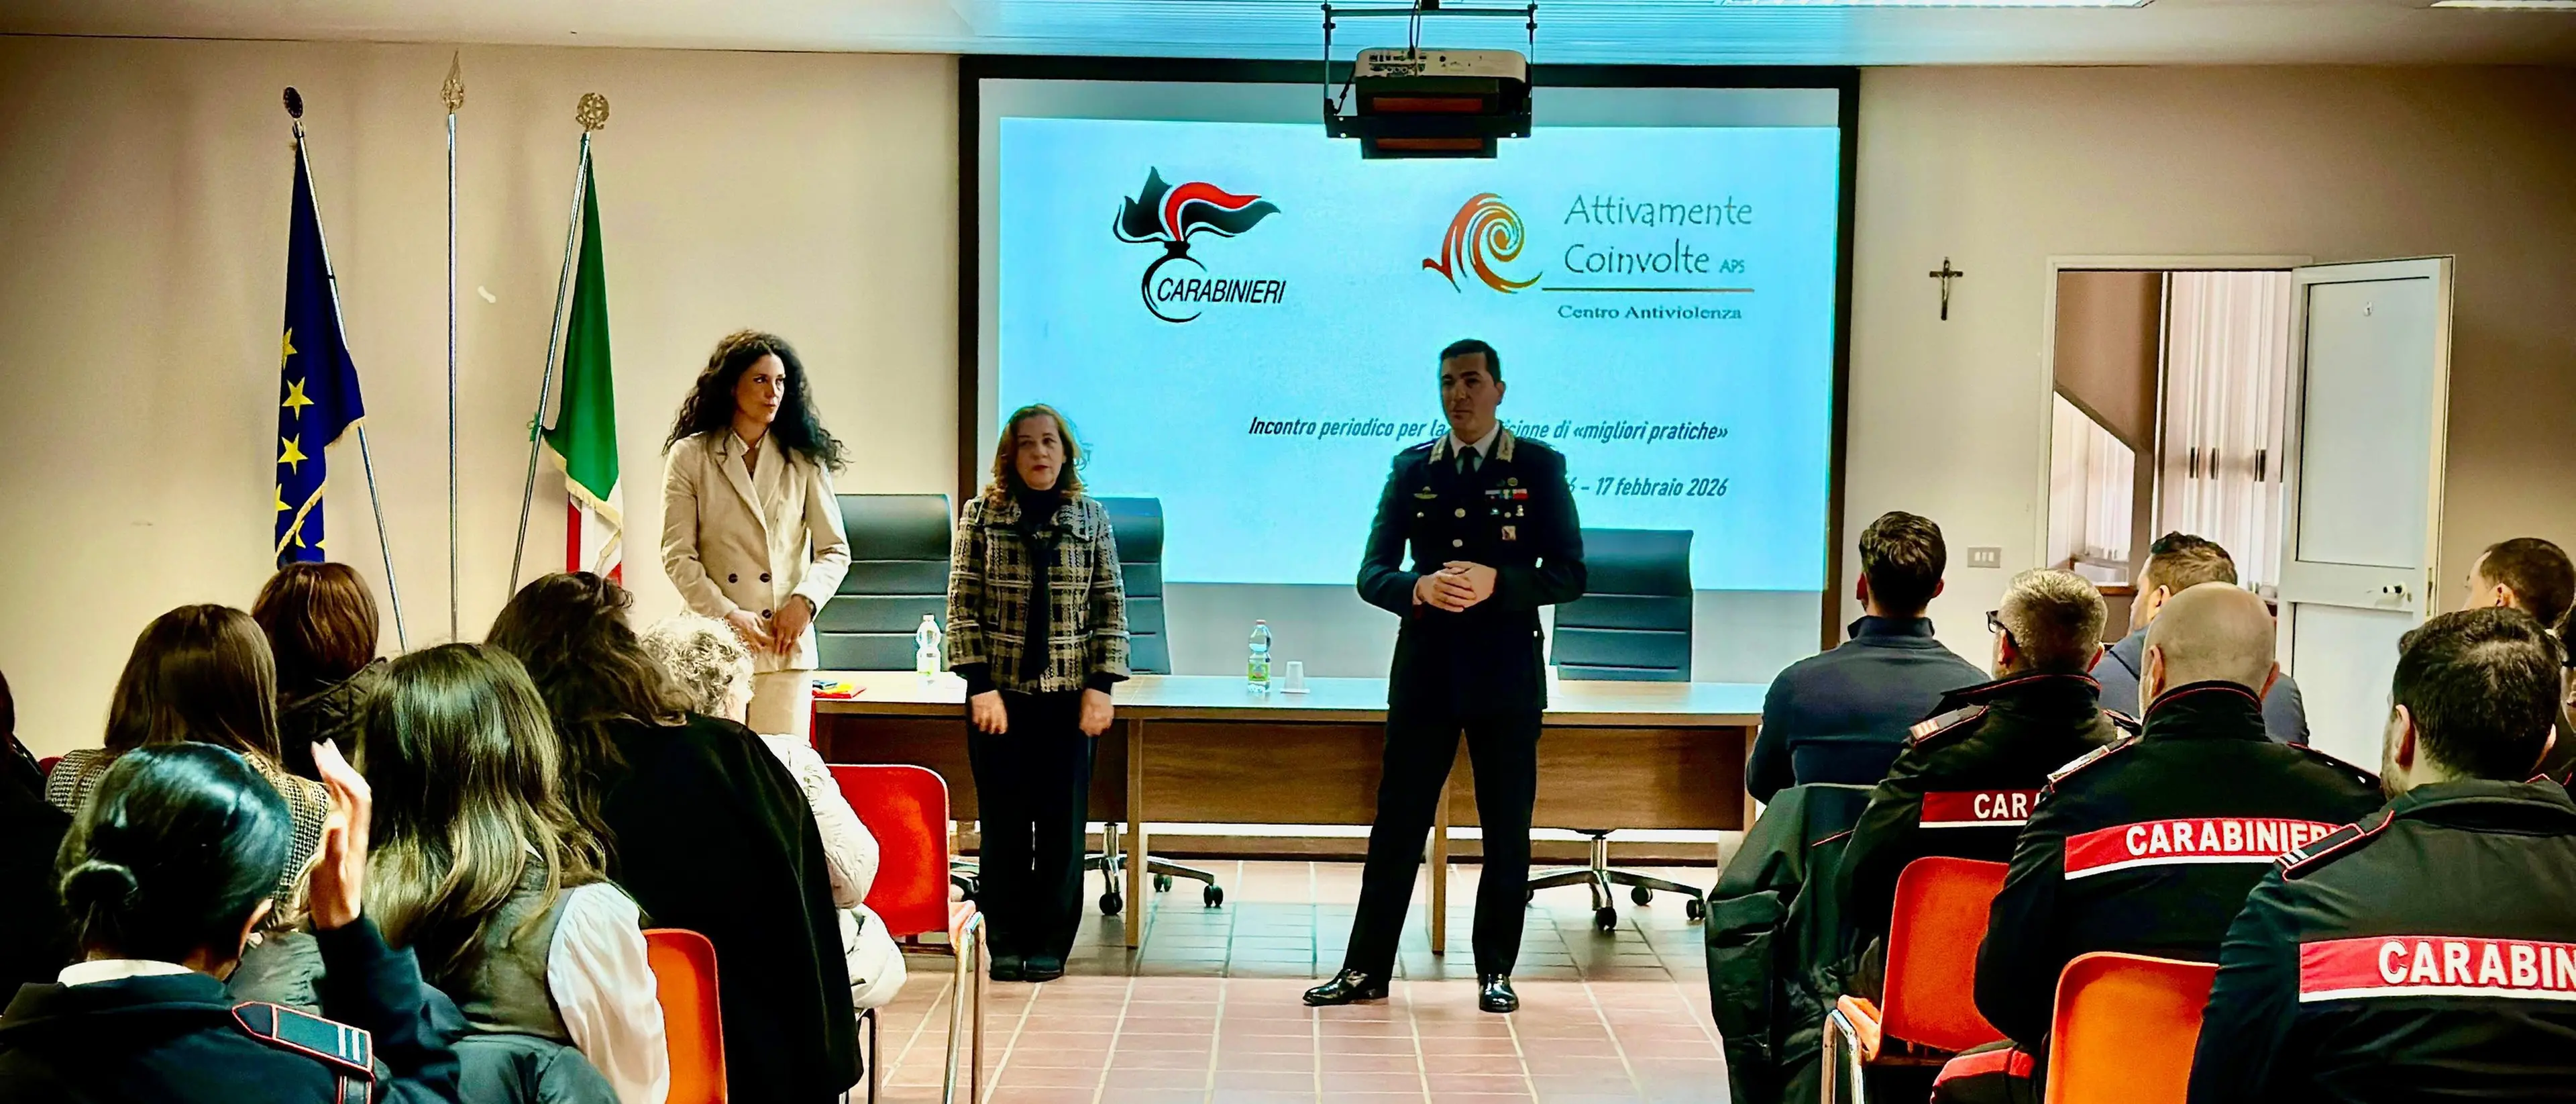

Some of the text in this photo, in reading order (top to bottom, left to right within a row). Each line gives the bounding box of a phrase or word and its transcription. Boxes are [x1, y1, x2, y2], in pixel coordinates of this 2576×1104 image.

[1564, 195, 1752, 227] Attivamente
[1564, 238, 1746, 274] Coinvolte APS
[1157, 277, 1287, 304] CARABINIERI
[1557, 305, 1742, 319] Centro Antiviolenza
[1248, 416, 1316, 436] Incontro
[1318, 417, 1393, 440] periodico
[1395, 422, 1428, 441] per
[1430, 419, 1447, 437] la
[1553, 420, 1572, 438] di
[1573, 421, 1650, 444] «migliori
[1647, 421, 1729, 444] pratiche»
[1595, 476, 1615, 495] 17
[1615, 476, 1684, 497] febbraio
[1686, 478, 1729, 497] 2026
[2125, 819, 2339, 856] CARABINIER
